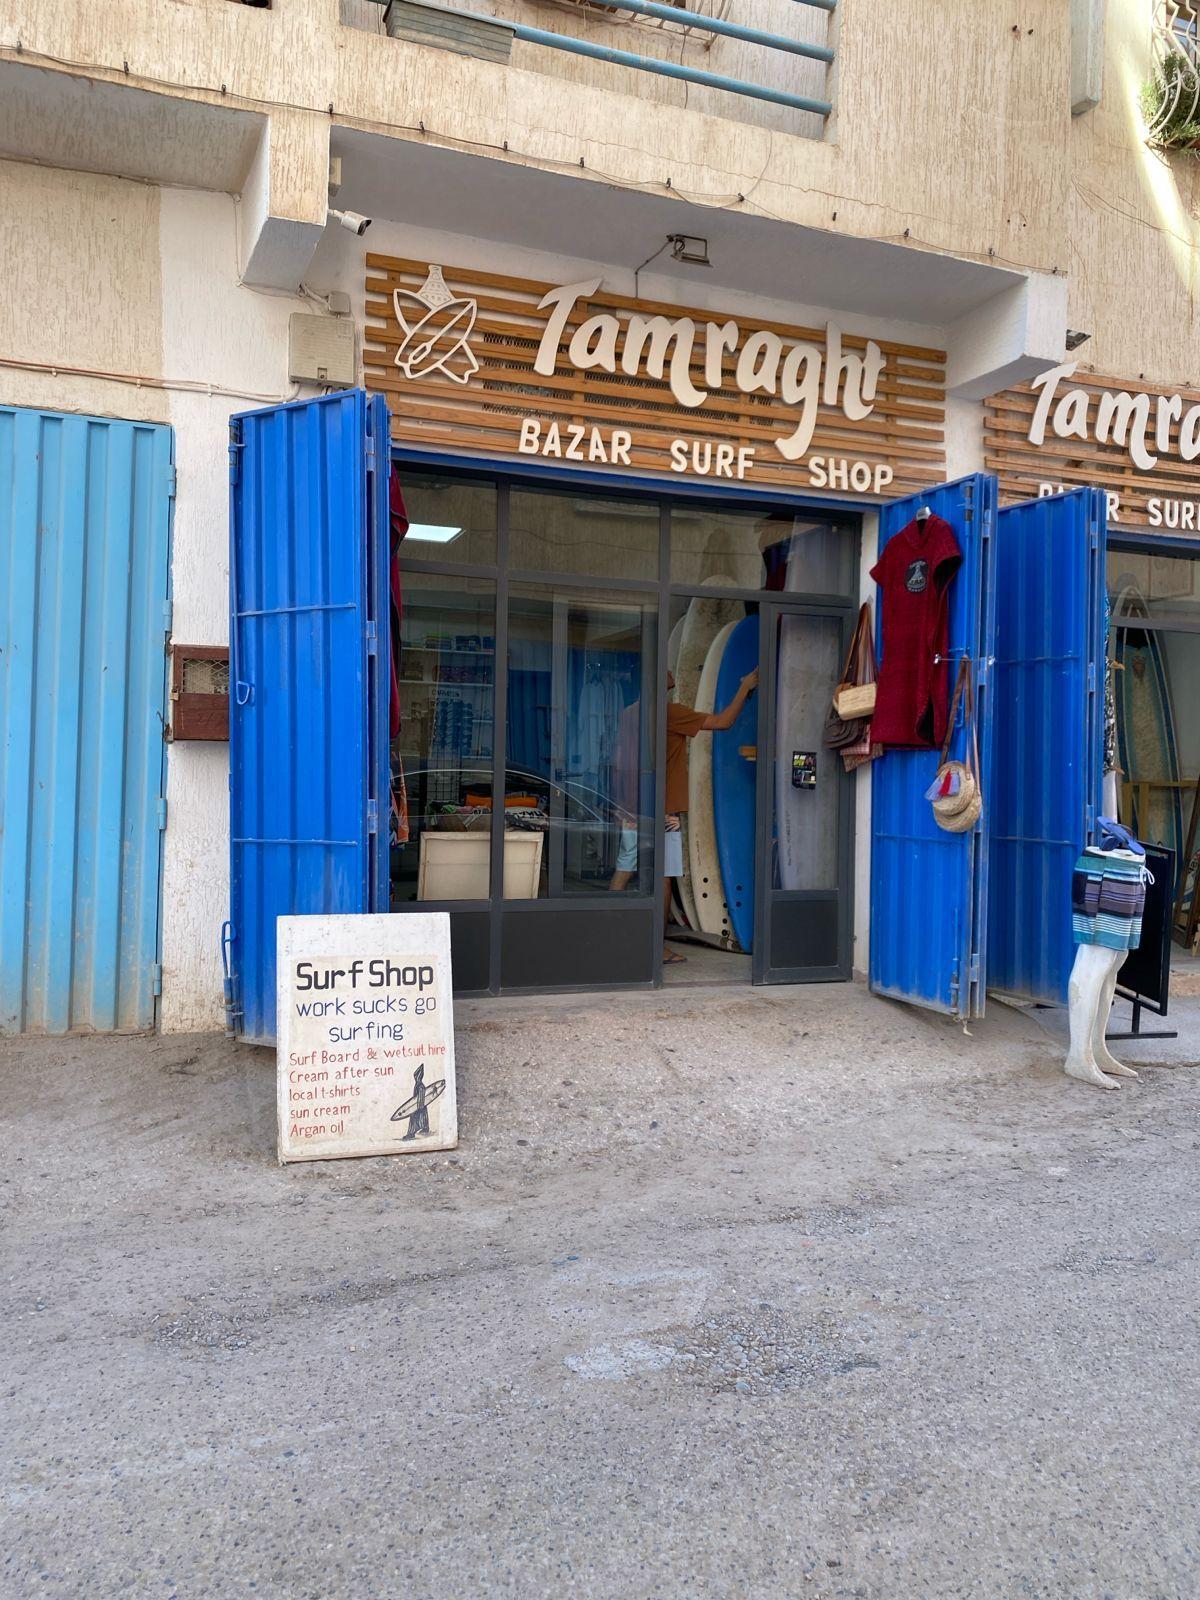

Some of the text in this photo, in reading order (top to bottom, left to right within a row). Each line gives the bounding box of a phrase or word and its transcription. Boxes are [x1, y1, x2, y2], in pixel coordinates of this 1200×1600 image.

[533, 277, 886, 461] Tamraght
[518, 417, 894, 494] BAZAR SURF SHOP
[1147, 497, 1200, 531] SUR
[296, 959, 434, 991] Surf Shop
[295, 994, 437, 1017] work sucks go
[328, 1021, 404, 1043] surfing
[288, 1051, 318, 1067] Surf
[321, 1048, 361, 1065] Board
[366, 1047, 378, 1061] &
[428, 1043, 446, 1056] hire
[289, 1066, 394, 1084] Cream after sun
[288, 1084, 361, 1101] local t-shirts
[290, 1104, 351, 1119] sun cream
[290, 1119, 344, 1139] Argan oil
